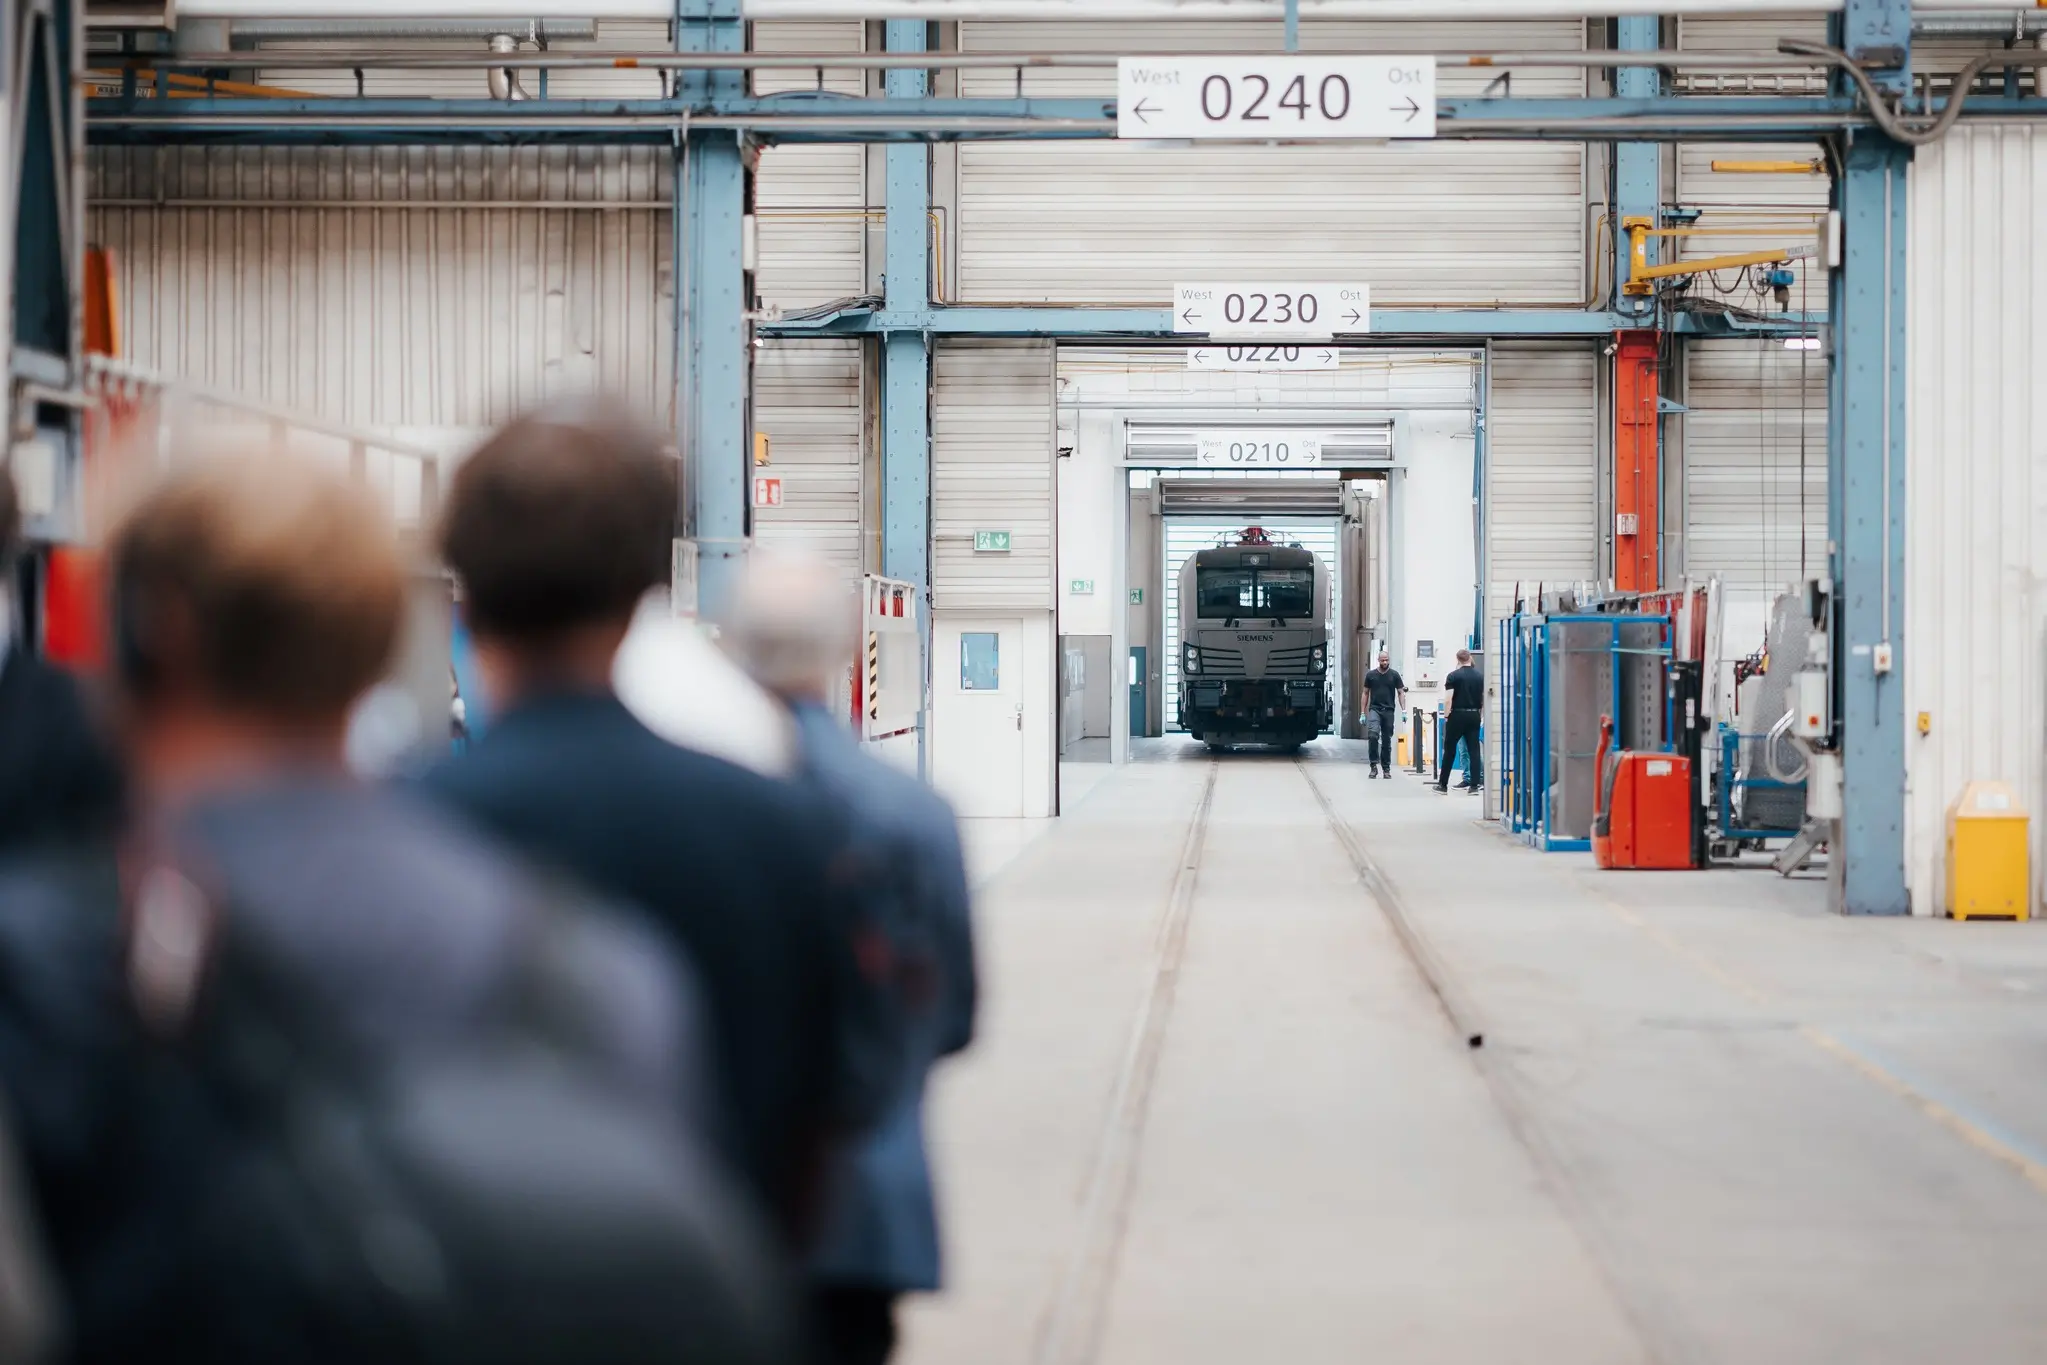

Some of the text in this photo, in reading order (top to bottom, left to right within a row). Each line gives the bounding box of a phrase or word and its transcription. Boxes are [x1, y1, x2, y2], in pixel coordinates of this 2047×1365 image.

[1131, 67, 1422, 121] West 0240 Ost
[1181, 289, 1361, 324] West 0230 Ost
[1227, 346, 1300, 362] 0220
[1202, 440, 1222, 448] West
[1229, 442, 1289, 462] 0210
[1236, 634, 1274, 642] SIEMENS
